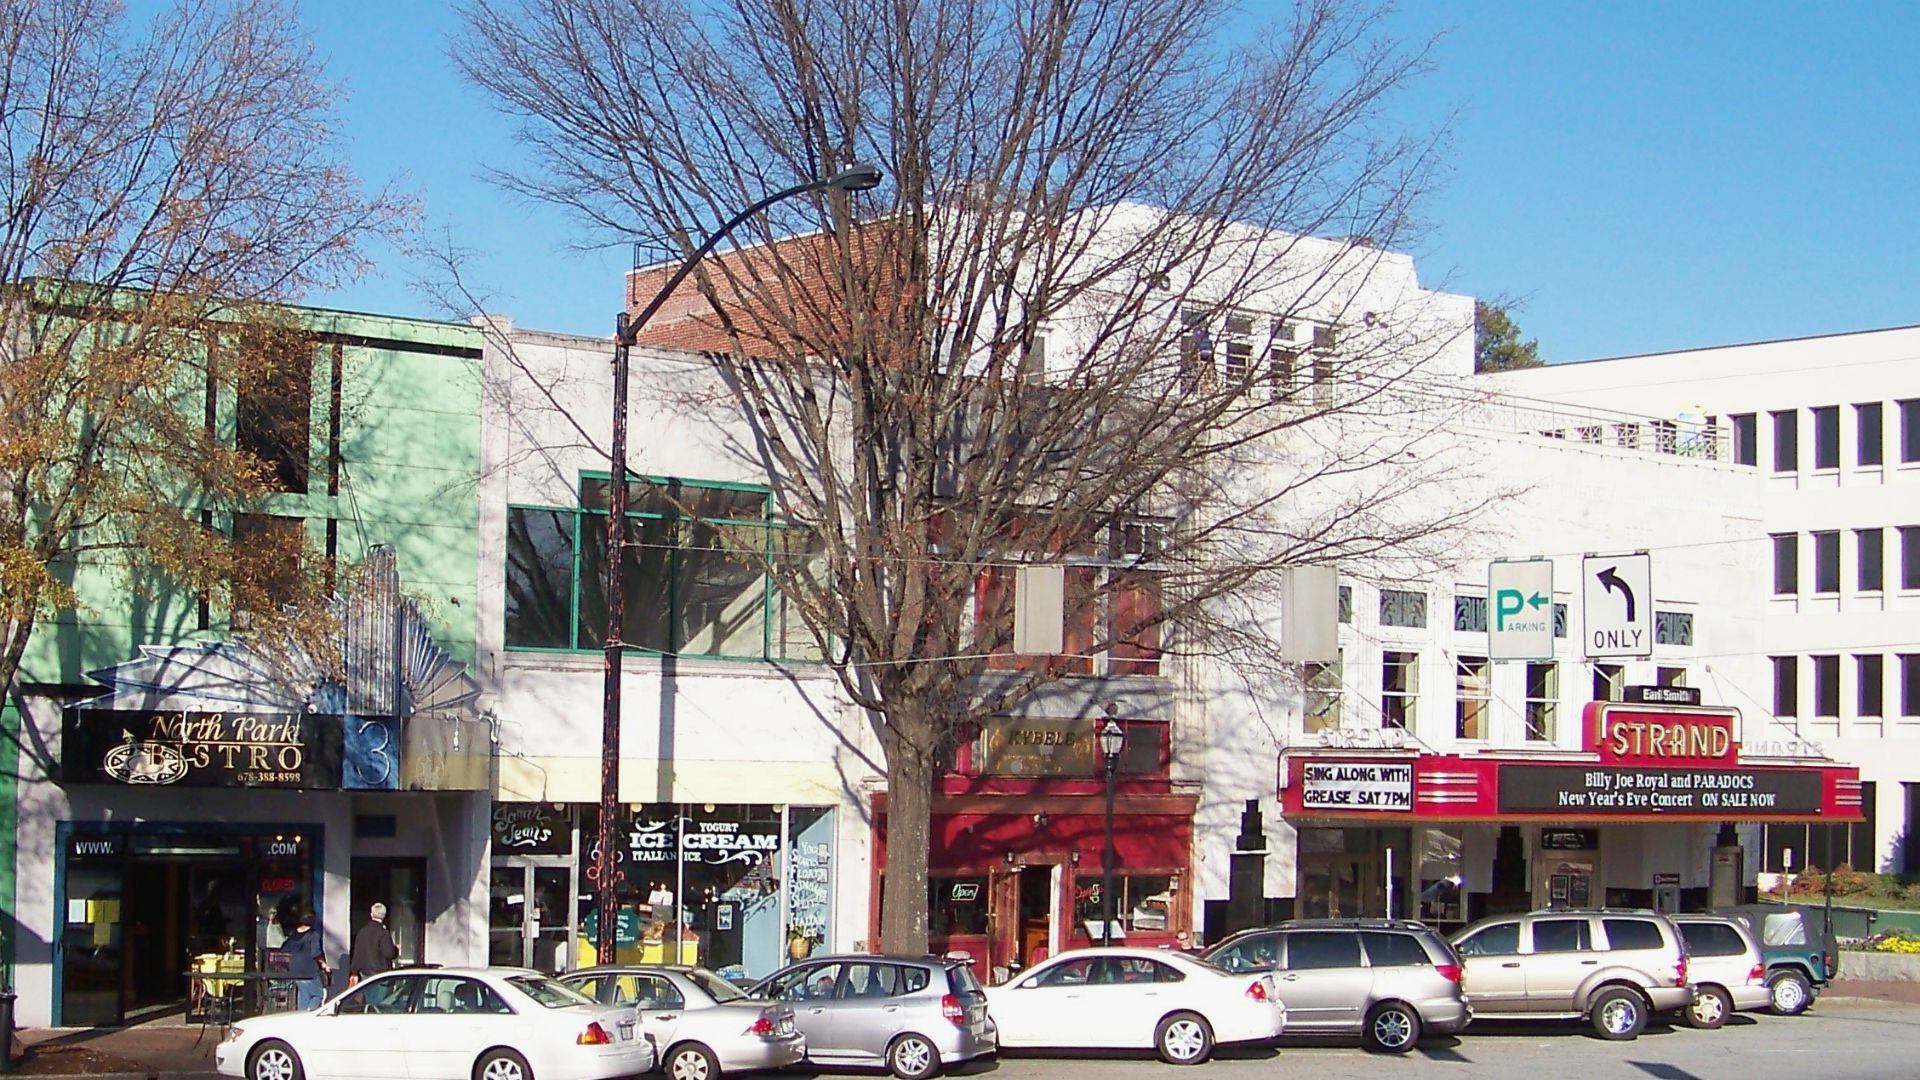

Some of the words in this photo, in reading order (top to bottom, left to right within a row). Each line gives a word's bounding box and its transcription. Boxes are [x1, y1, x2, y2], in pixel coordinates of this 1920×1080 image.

[1594, 629, 1642, 648] ONLY
[150, 713, 225, 741] North
[232, 715, 298, 742] Park
[1008, 730, 1076, 745] KYBELE
[1611, 721, 1730, 758] STRAND
[148, 744, 302, 770] BISTRO
[356, 721, 391, 784] 3
[1305, 767, 1333, 780] SING
[1336, 768, 1375, 780] ALONG
[1380, 768, 1410, 782] WITH
[1585, 772, 1612, 790] Billy
[1615, 773, 1634, 789] Joe
[1636, 773, 1668, 790] Royal
[1671, 773, 1691, 788] and
[1693, 775, 1754, 789] PARADOCS
[1304, 790, 1351, 804] GREASE
[1358, 791, 1381, 805] SAT
[1559, 791, 1586, 806] New
[1588, 791, 1625, 806] Year's
[1626, 792, 1648, 806] Eve
[1650, 792, 1693, 806] Concert
[1702, 793, 1718, 806] ON
[1721, 793, 1748, 807] SALE
[1750, 793, 1776, 807] NOW
[502, 822, 552, 845] Jean's
[700, 822, 739, 832] YOGURT
[267, 843, 297, 855] .COM
[629, 832, 673, 848] ICE
[683, 834, 777, 850] CREAM
[632, 850, 677, 861] ITALIAN
[684, 851, 701, 862] ICE
[952, 884, 974, 900] Open
